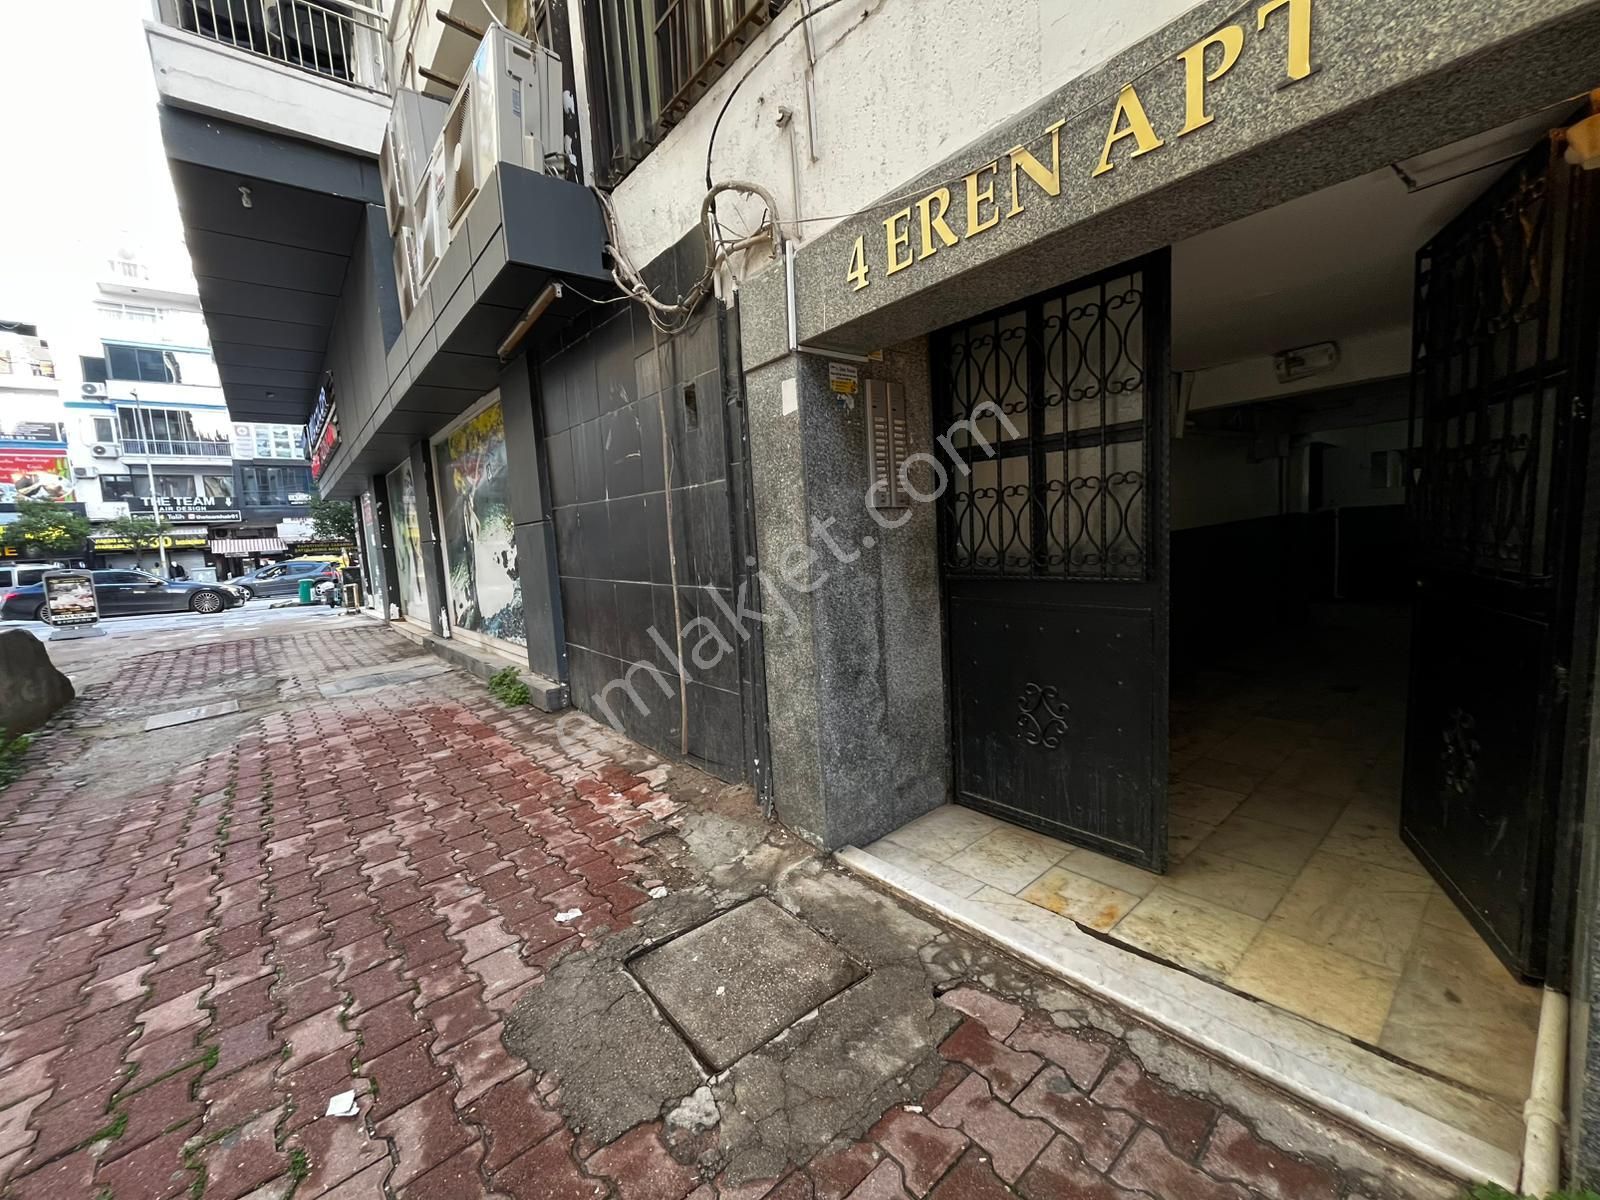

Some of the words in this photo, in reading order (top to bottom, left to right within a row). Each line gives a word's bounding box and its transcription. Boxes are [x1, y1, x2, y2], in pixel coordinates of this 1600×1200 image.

[846, 234, 870, 293] 4
[882, 117, 1066, 278] EREN
[1091, 0, 1313, 178] APT
[140, 496, 171, 506] THE
[173, 496, 215, 506] TEAM
